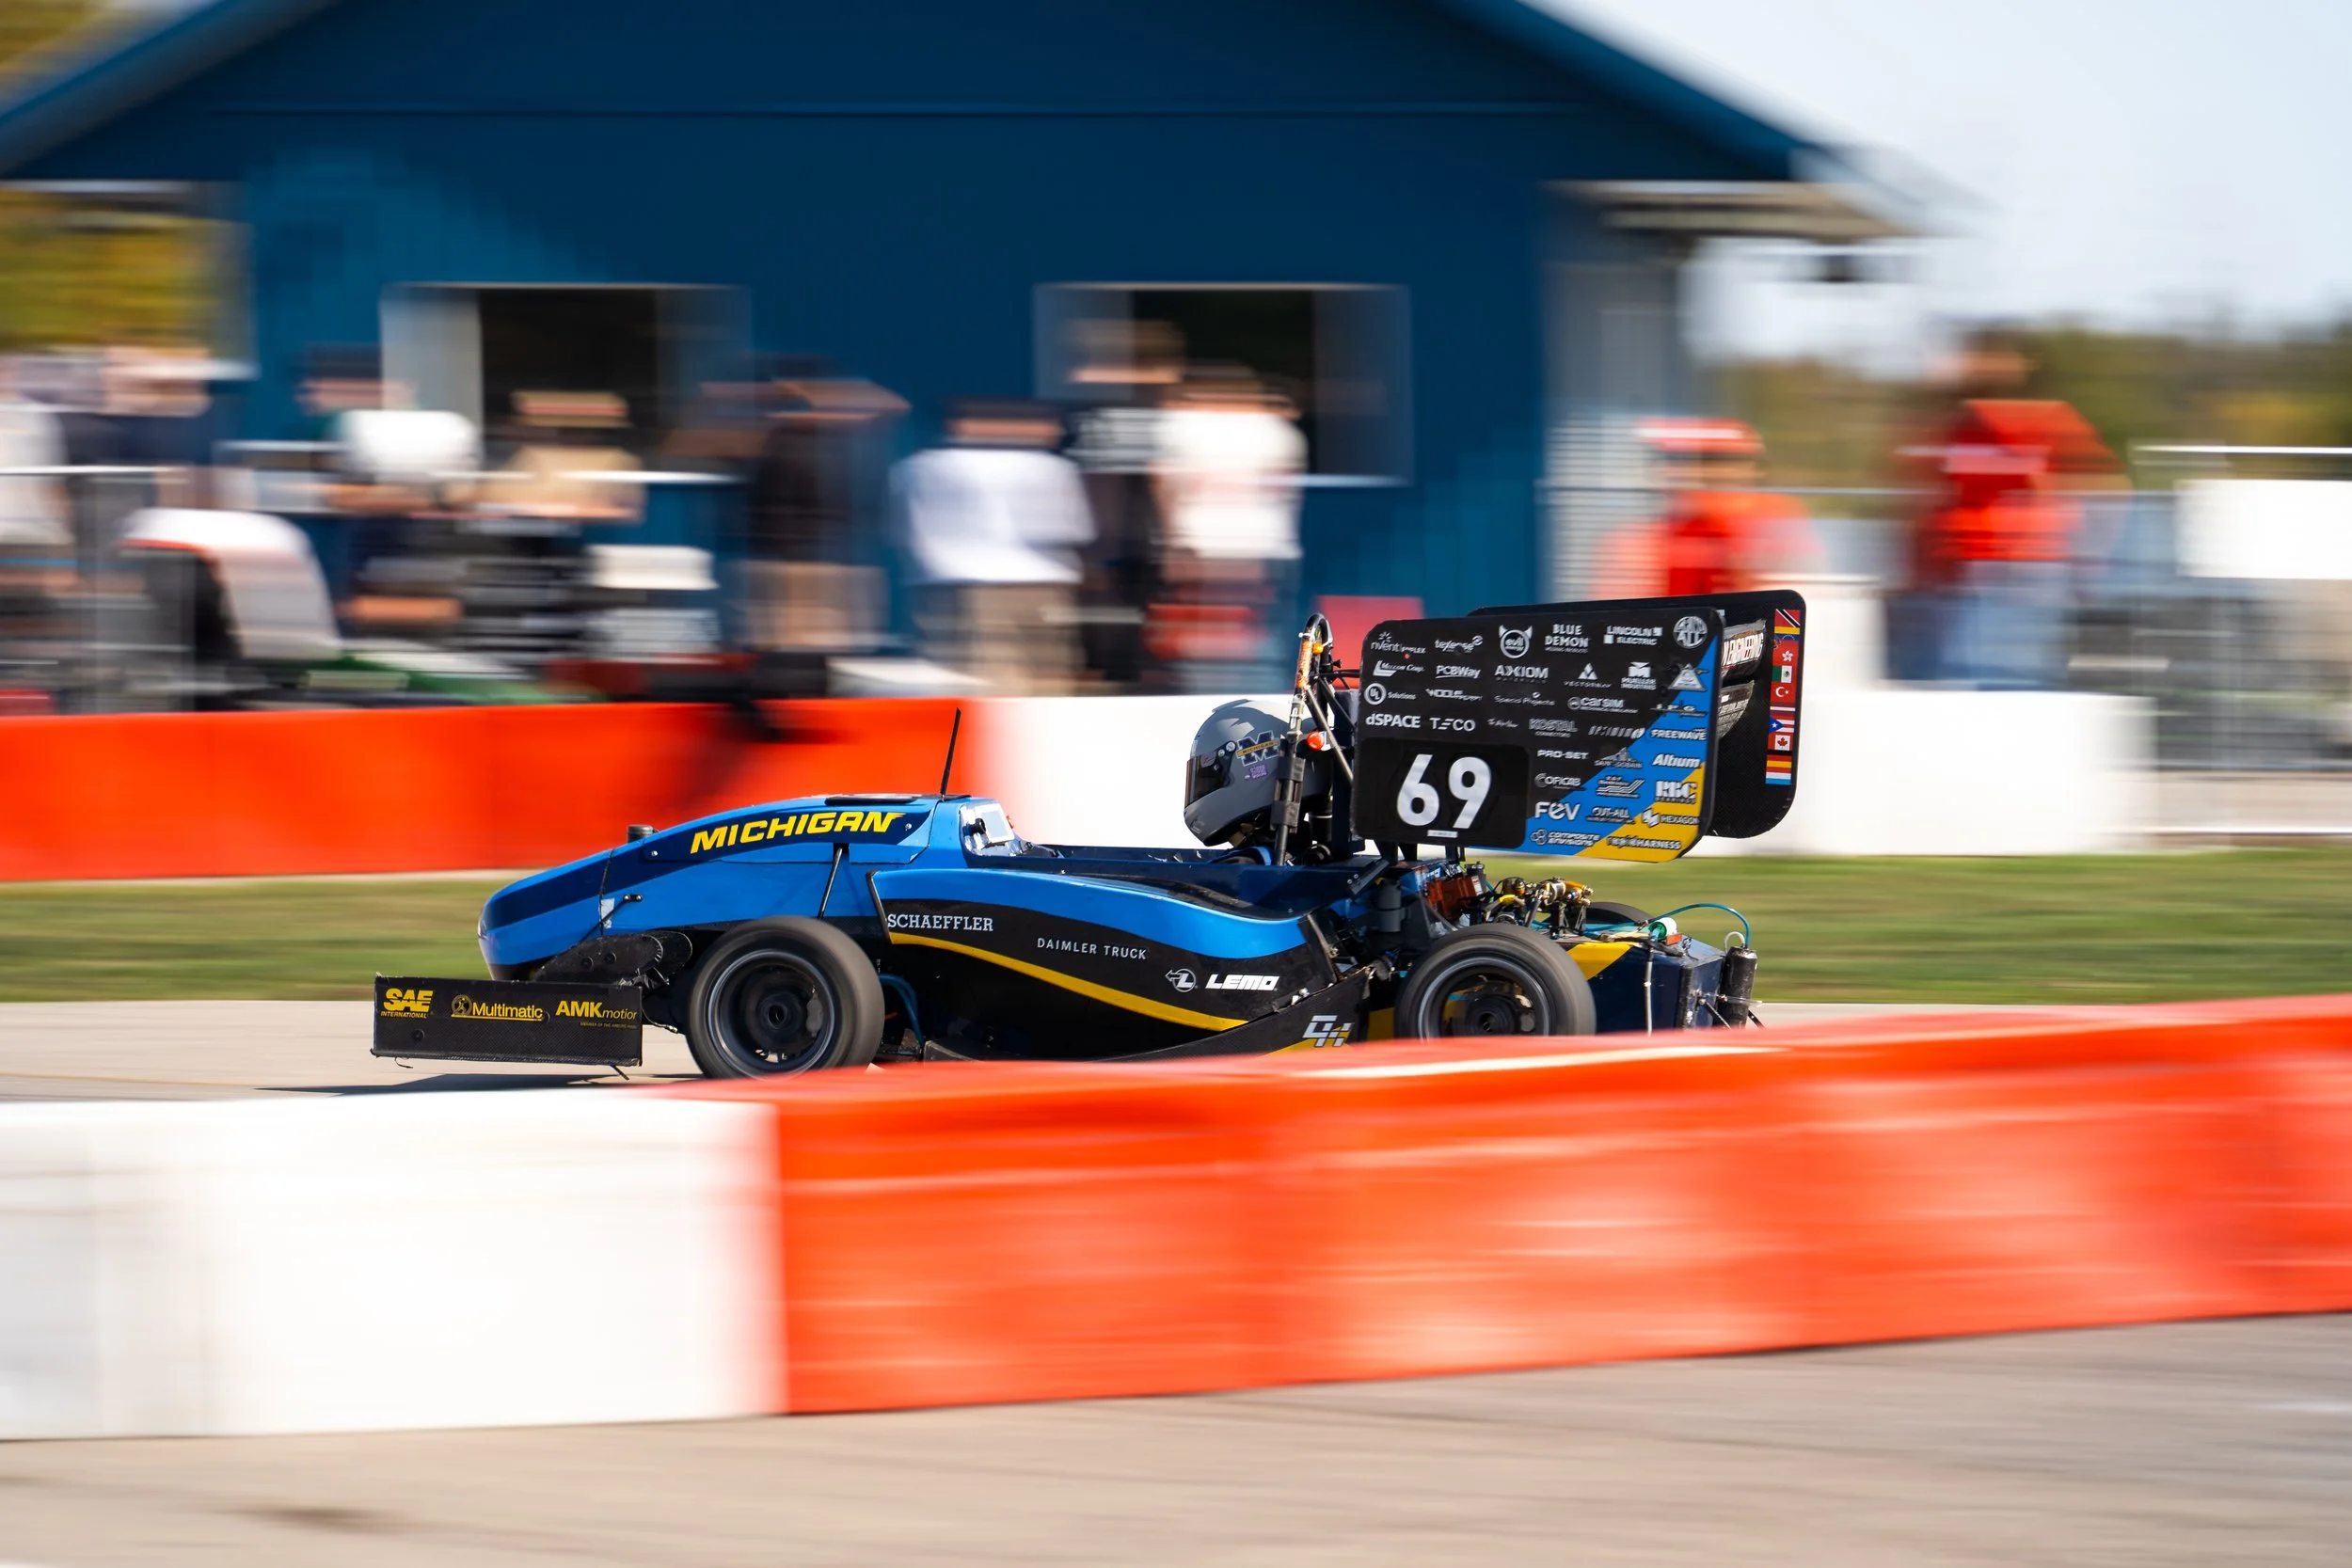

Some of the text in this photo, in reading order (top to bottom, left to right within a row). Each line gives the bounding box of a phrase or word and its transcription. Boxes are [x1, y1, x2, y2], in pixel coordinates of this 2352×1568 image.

[1552, 624, 1582, 636] BLUE
[1606, 626, 1653, 637] LINCOLN
[1545, 635, 1589, 648] DEMON
[1616, 637, 1657, 646] ELECTRIC
[1436, 665, 1482, 678] PCBWay
[1370, 688, 1417, 701] UL Solutions
[1365, 713, 1422, 728] dSPACE
[1429, 717, 1476, 732] TECO
[1529, 718, 1579, 733] KOSTAL
[1651, 729, 1707, 740] FREEWAVE
[1537, 750, 1589, 759] PRO-SET
[1652, 753, 1702, 768] Altium
[1396, 753, 1492, 829] 69
[690, 811, 906, 854] MICHIGAN
[887, 913, 993, 932] SCHAEFFLER
[1037, 938, 1147, 960] DAIMLER TRUCK
[1205, 974, 1280, 991] LEMO
[383, 988, 434, 1012] SAE
[472, 1002, 543, 1019] Multimatic
